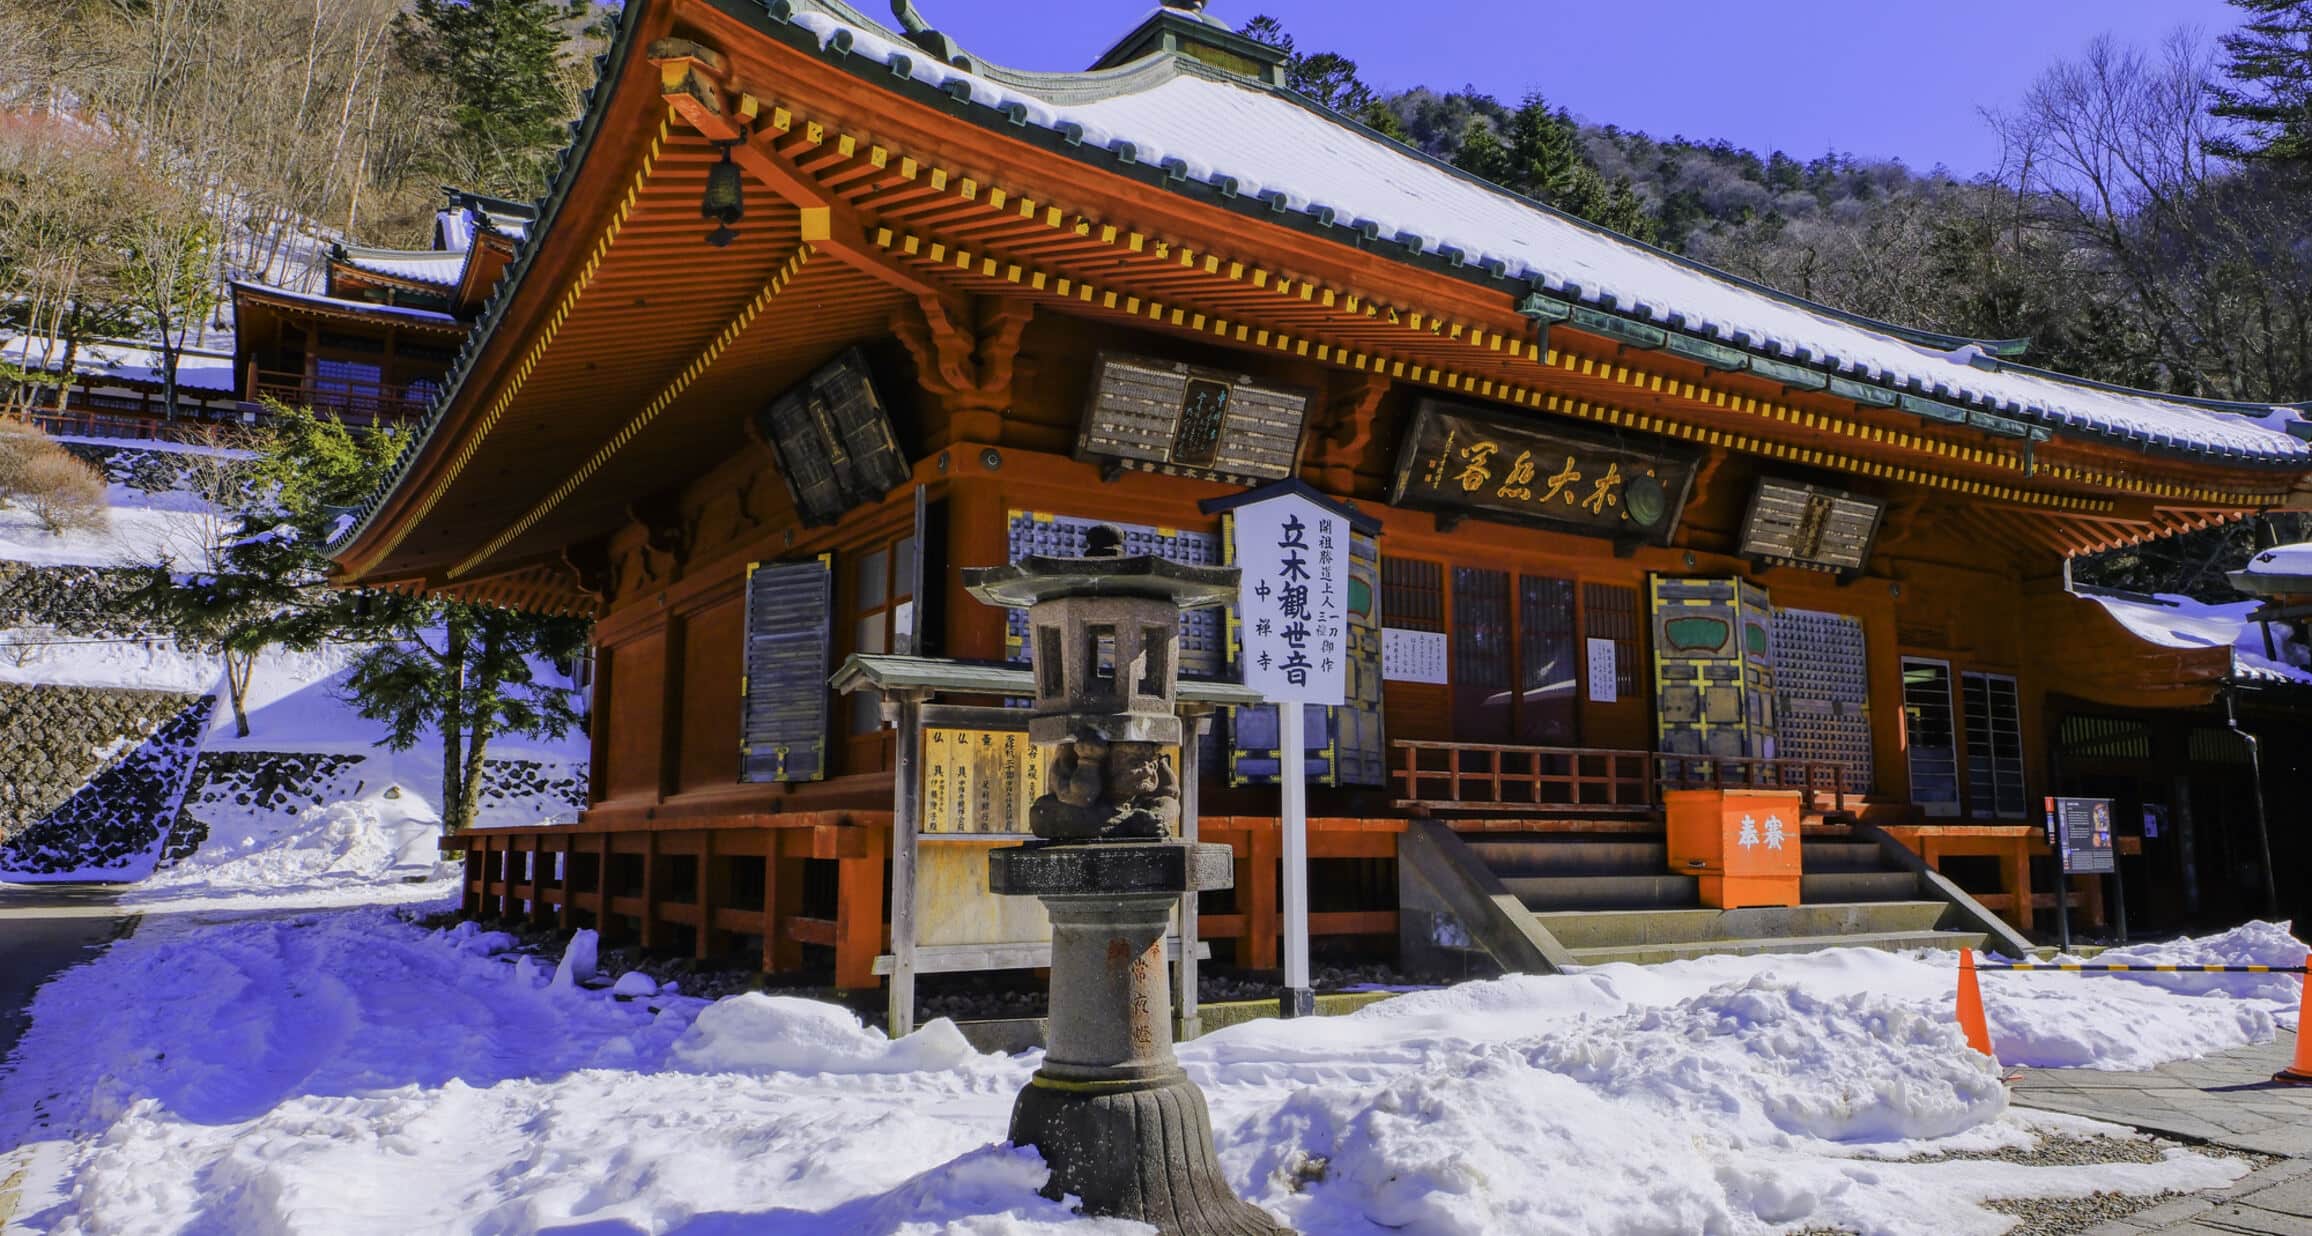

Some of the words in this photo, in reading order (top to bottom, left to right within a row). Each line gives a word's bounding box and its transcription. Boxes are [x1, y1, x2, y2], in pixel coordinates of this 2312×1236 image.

[1255, 579, 1273, 672] 中禅寺
[1277, 514, 1312, 687] 立木観世音
